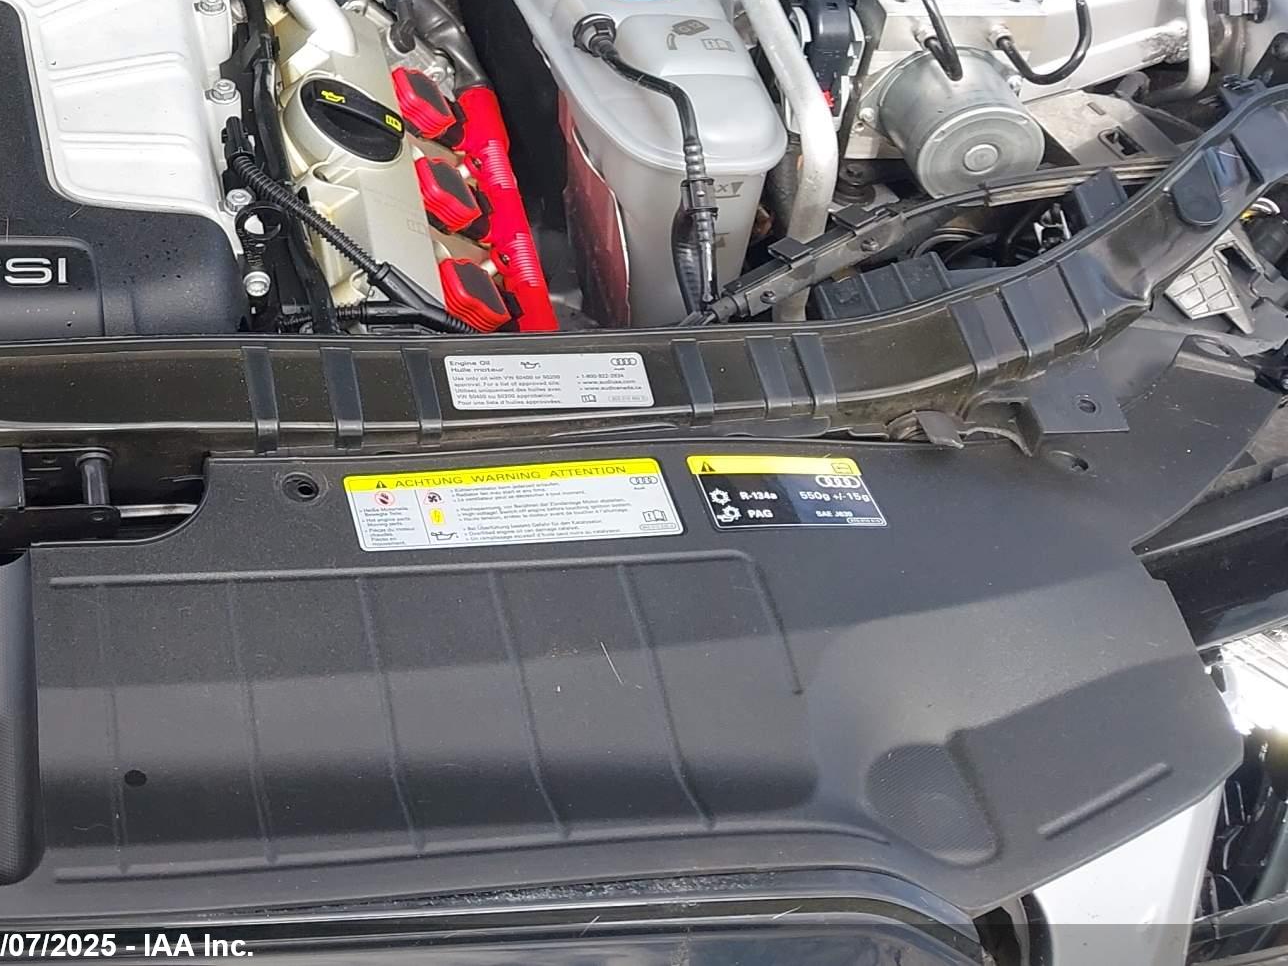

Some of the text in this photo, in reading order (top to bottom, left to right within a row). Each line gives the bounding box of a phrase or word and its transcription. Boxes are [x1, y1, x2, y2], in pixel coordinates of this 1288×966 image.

[395, 466, 627, 487] ACHTUNG WARNING ATTENTION
[739, 491, 778, 501] R-134a
[799, 491, 831, 502] 550g
[747, 509, 774, 519] PAG
